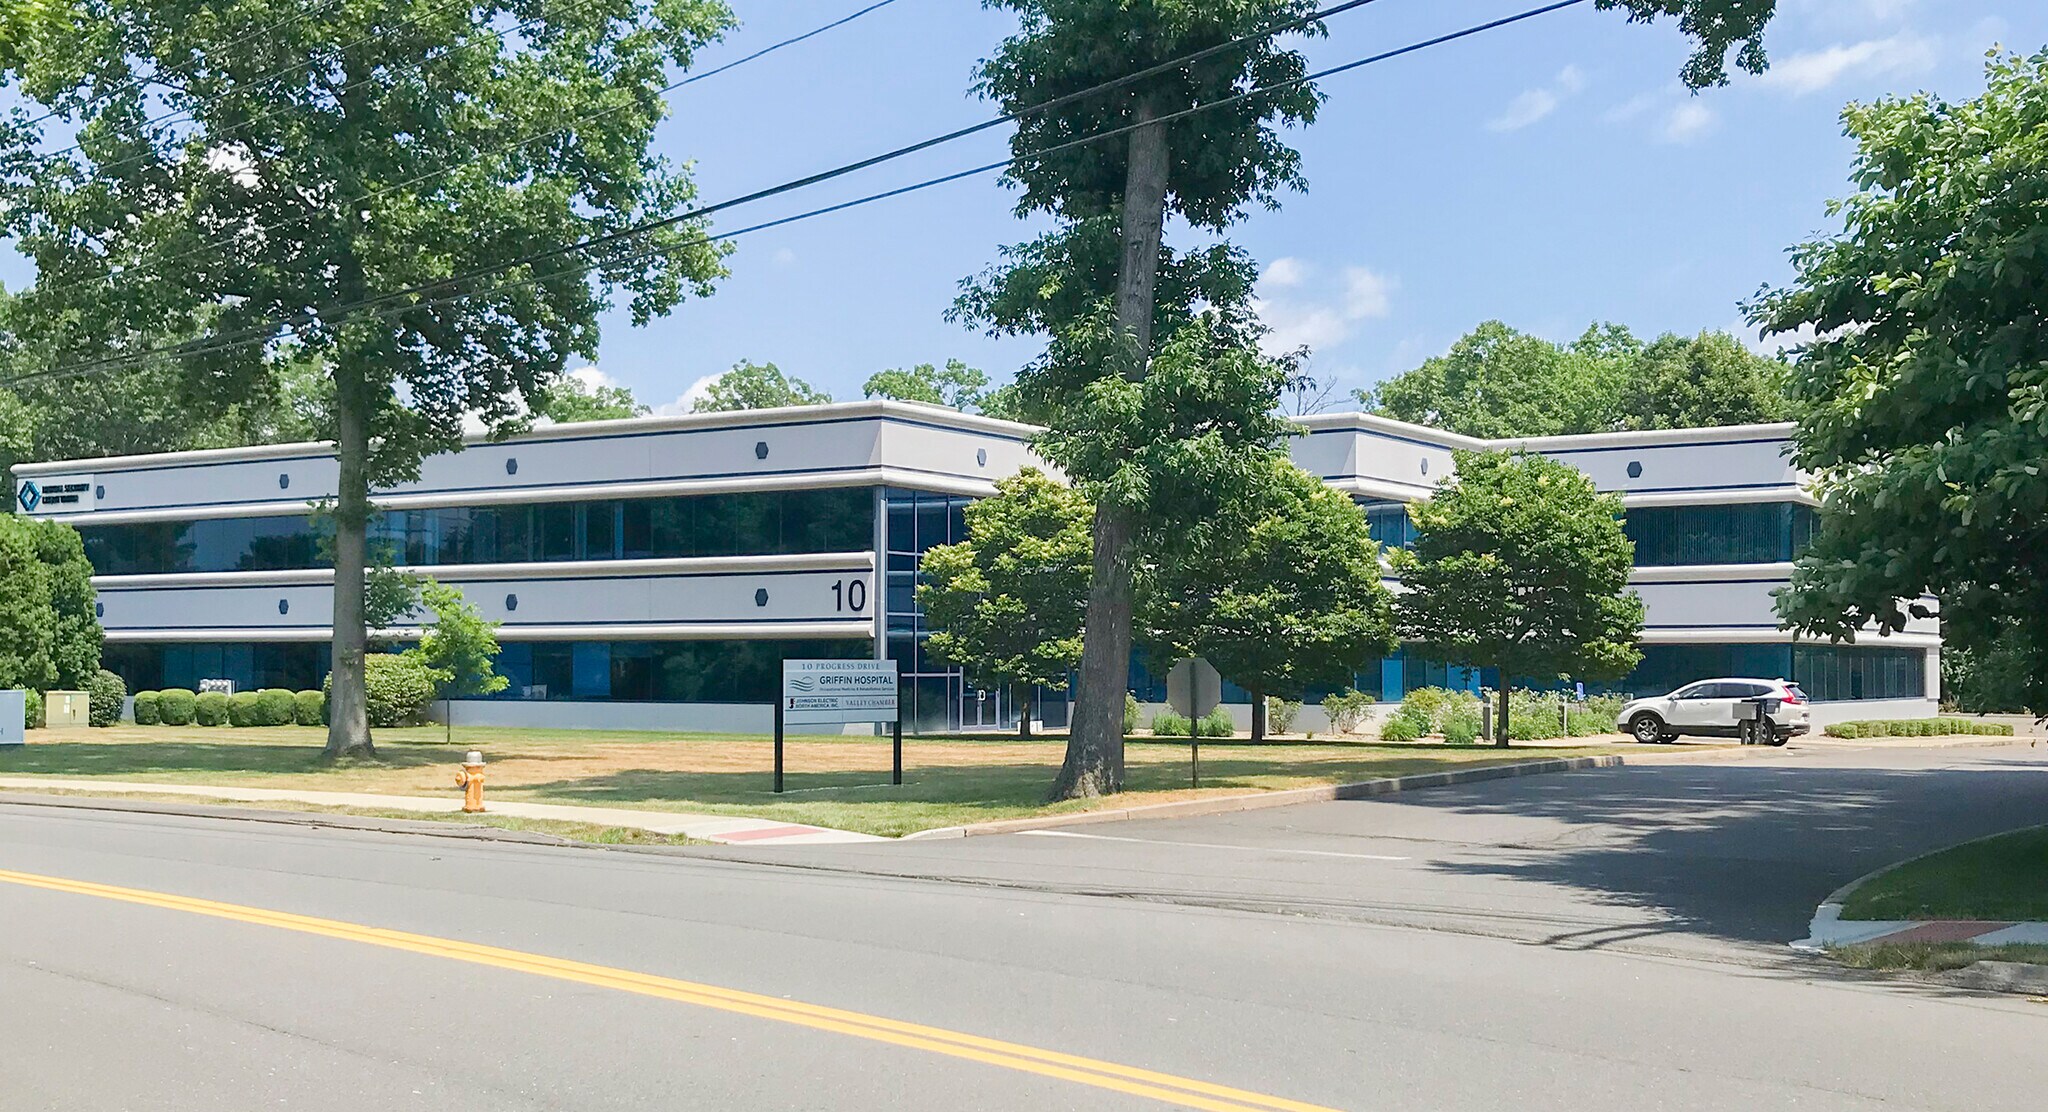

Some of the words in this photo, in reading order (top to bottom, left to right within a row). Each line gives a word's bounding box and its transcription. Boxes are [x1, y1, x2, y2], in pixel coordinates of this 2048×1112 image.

[832, 580, 866, 612] 10
[819, 676, 853, 685] GRIFFIN
[854, 676, 893, 685] HOSPITAL
[867, 698, 895, 706] CHAMBER
